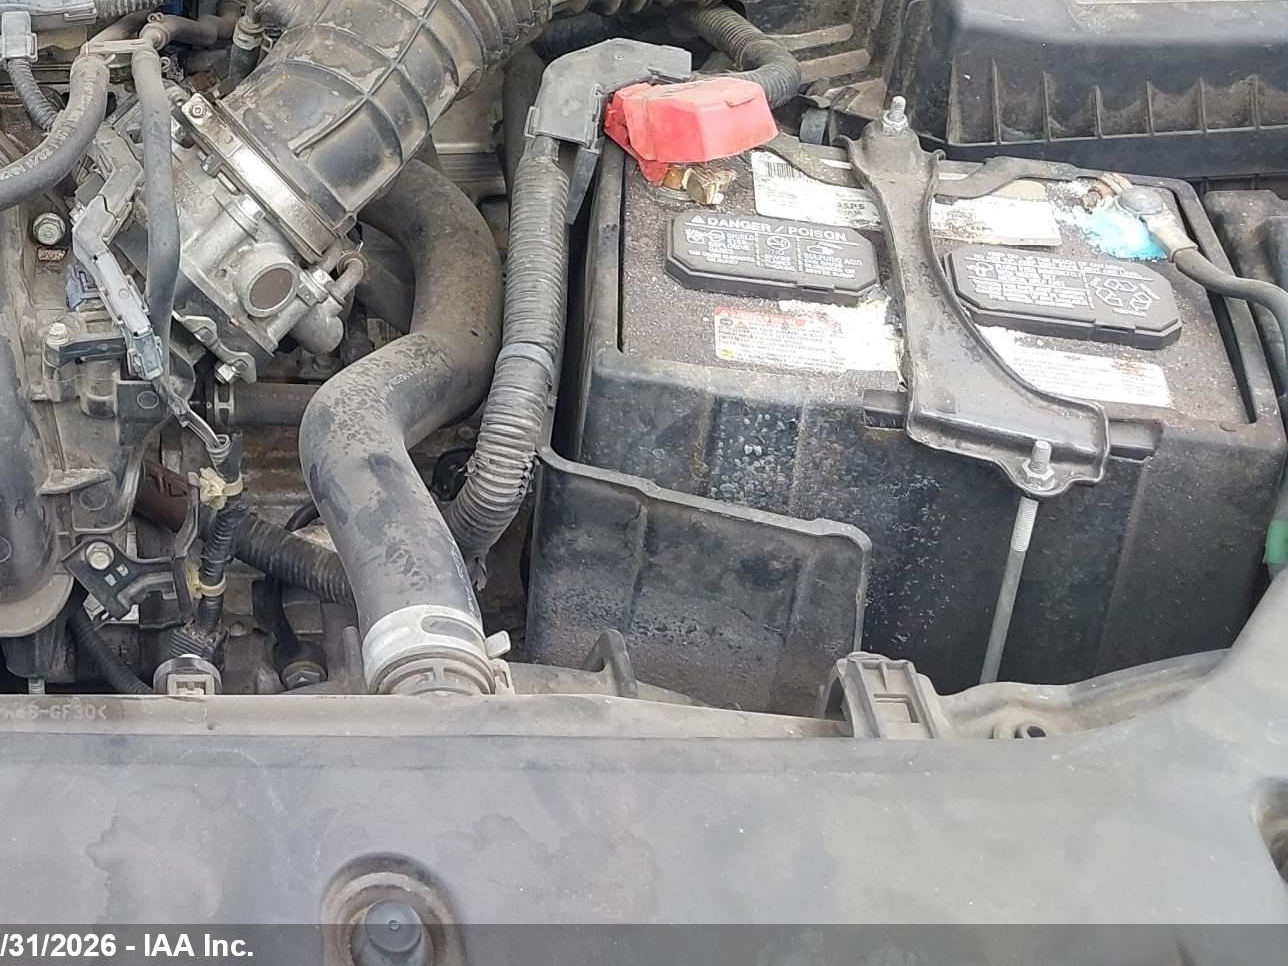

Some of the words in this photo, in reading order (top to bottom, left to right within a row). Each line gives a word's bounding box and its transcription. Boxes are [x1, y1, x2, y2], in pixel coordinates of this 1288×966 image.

[707, 217, 771, 233] DANGER
[774, 225, 785, 233] /
[788, 226, 847, 242] POISON
[843, 258, 862, 267] ACID
